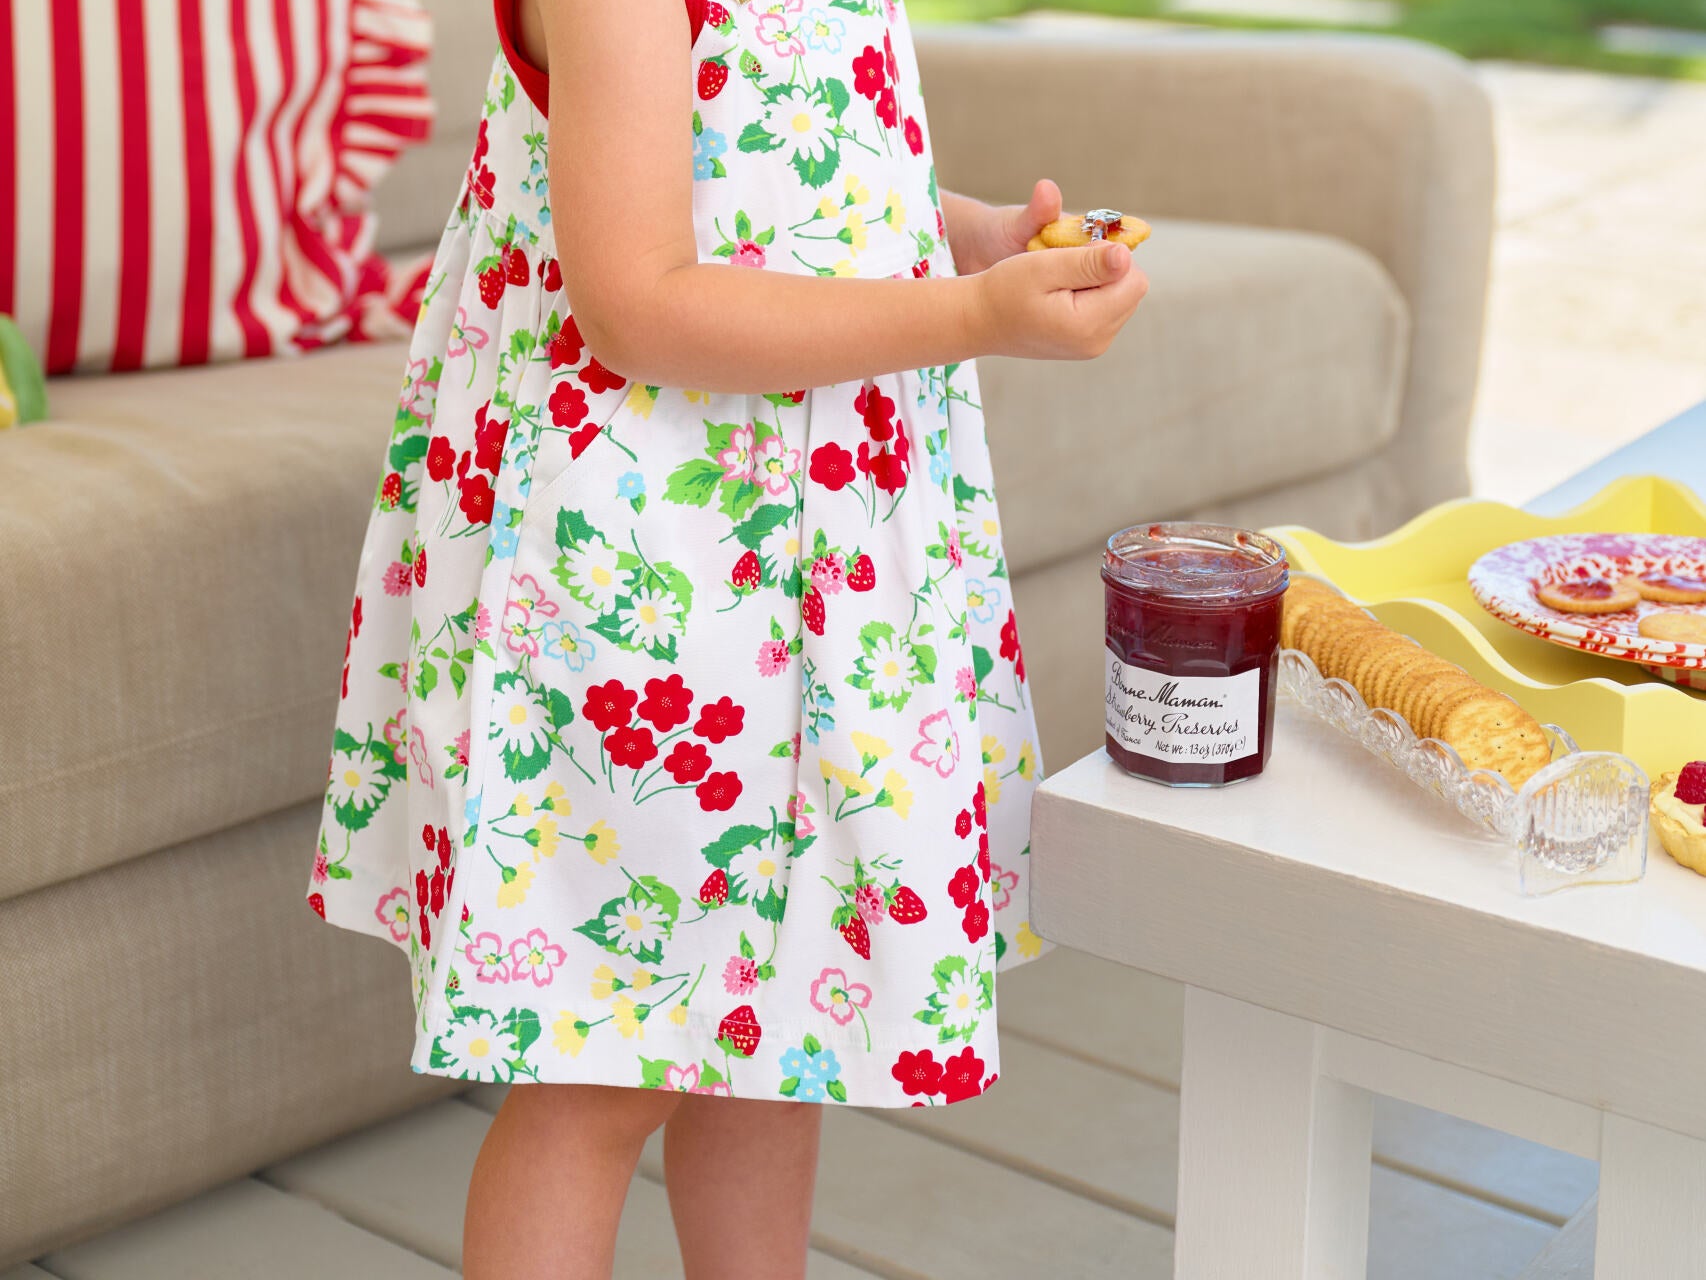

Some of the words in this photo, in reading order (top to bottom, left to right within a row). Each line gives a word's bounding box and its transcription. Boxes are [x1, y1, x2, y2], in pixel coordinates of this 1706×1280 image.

[1112, 661, 1147, 700] Bonne
[1105, 685, 1157, 736] Strawberry
[1161, 712, 1239, 736] Preserves
[1155, 739, 1170, 753] Net
